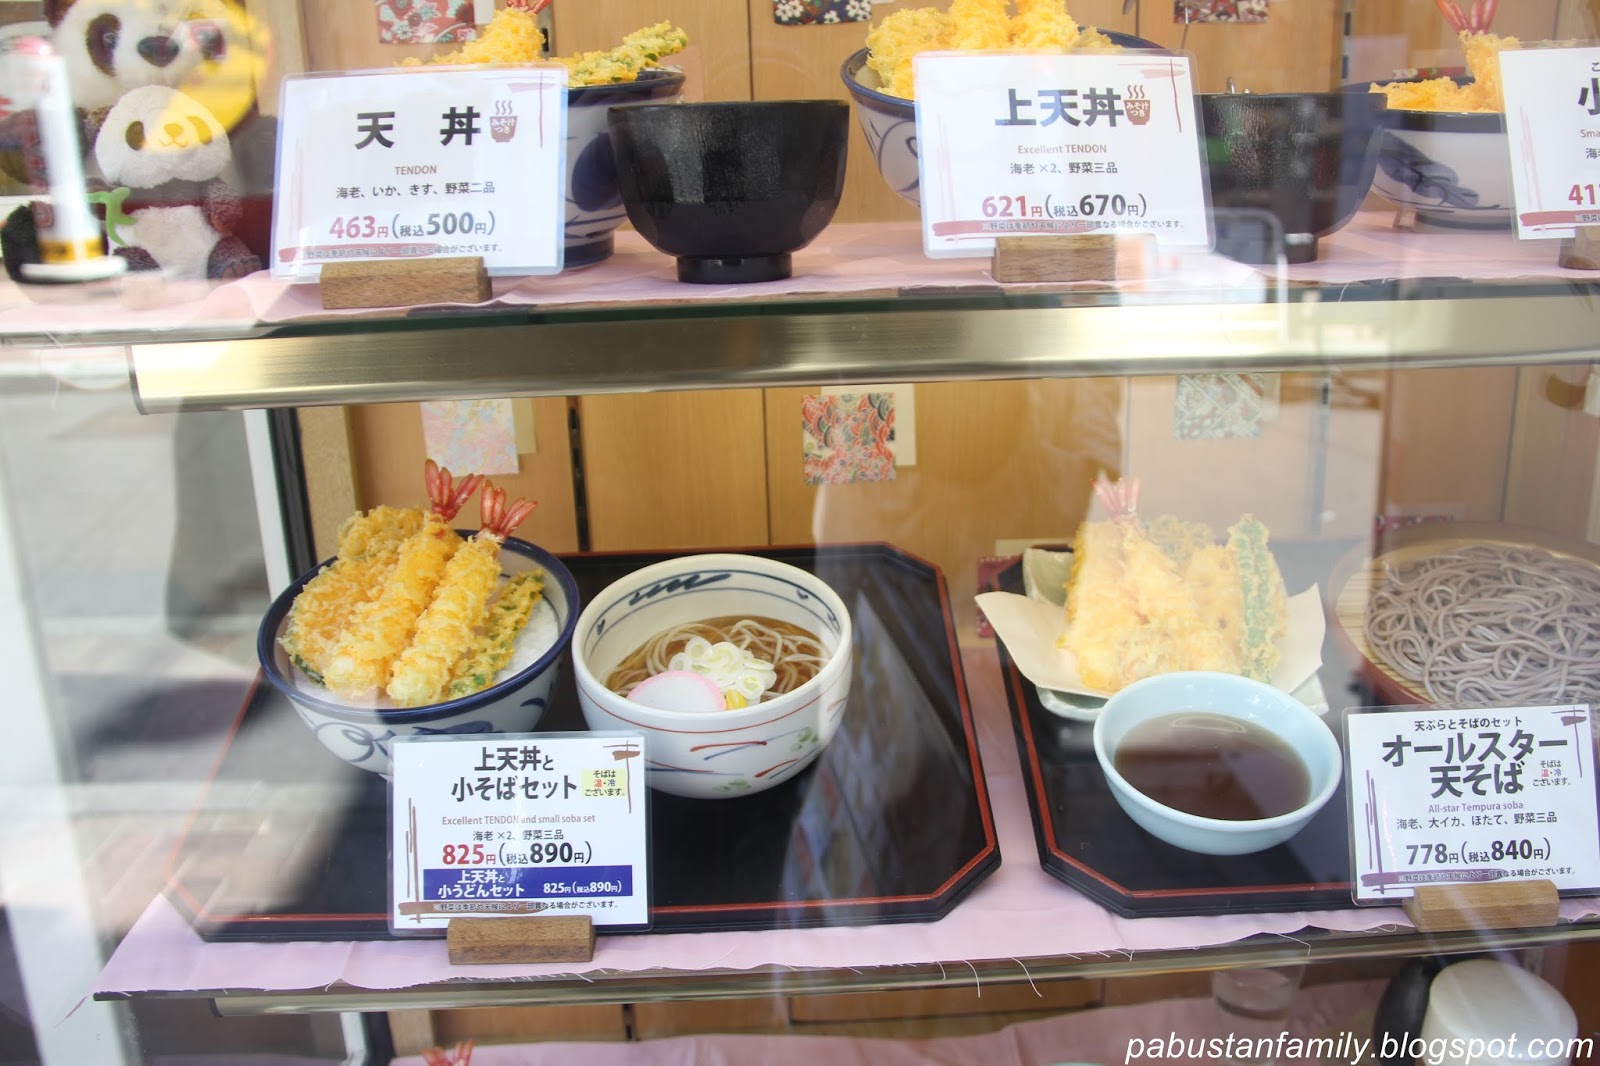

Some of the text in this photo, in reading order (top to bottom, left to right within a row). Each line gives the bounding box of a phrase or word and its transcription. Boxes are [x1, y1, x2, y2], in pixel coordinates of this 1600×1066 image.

[994, 87, 1125, 128] 上天丼
[1130, 109, 1146, 117] つき
[1017, 144, 1107, 155] Excellent TENDON
[394, 165, 437, 176] TENDON
[336, 181, 496, 199] 海老、いか、きす、野菜二品
[1568, 183, 1600, 205] 41
[1414, 716, 1523, 732] 天ぷらとそばのセット
[1382, 729, 1568, 767] オールスター
[474, 745, 555, 772] 上天丼と
[1539, 760, 1562, 768] そばは
[592, 769, 616, 779] そばは
[1429, 760, 1526, 799] 天そば
[451, 774, 578, 803] 小そばセット
[1428, 801, 1524, 814] All-star Tempura soba
[442, 814, 596, 826] Excellent TENDON and small soba set
[1396, 811, 1558, 830] 海老、大イカ、ほたて、野菜三品
[457, 869, 505, 884] 上天丼と
[437, 883, 525, 899] 小うどんセット
